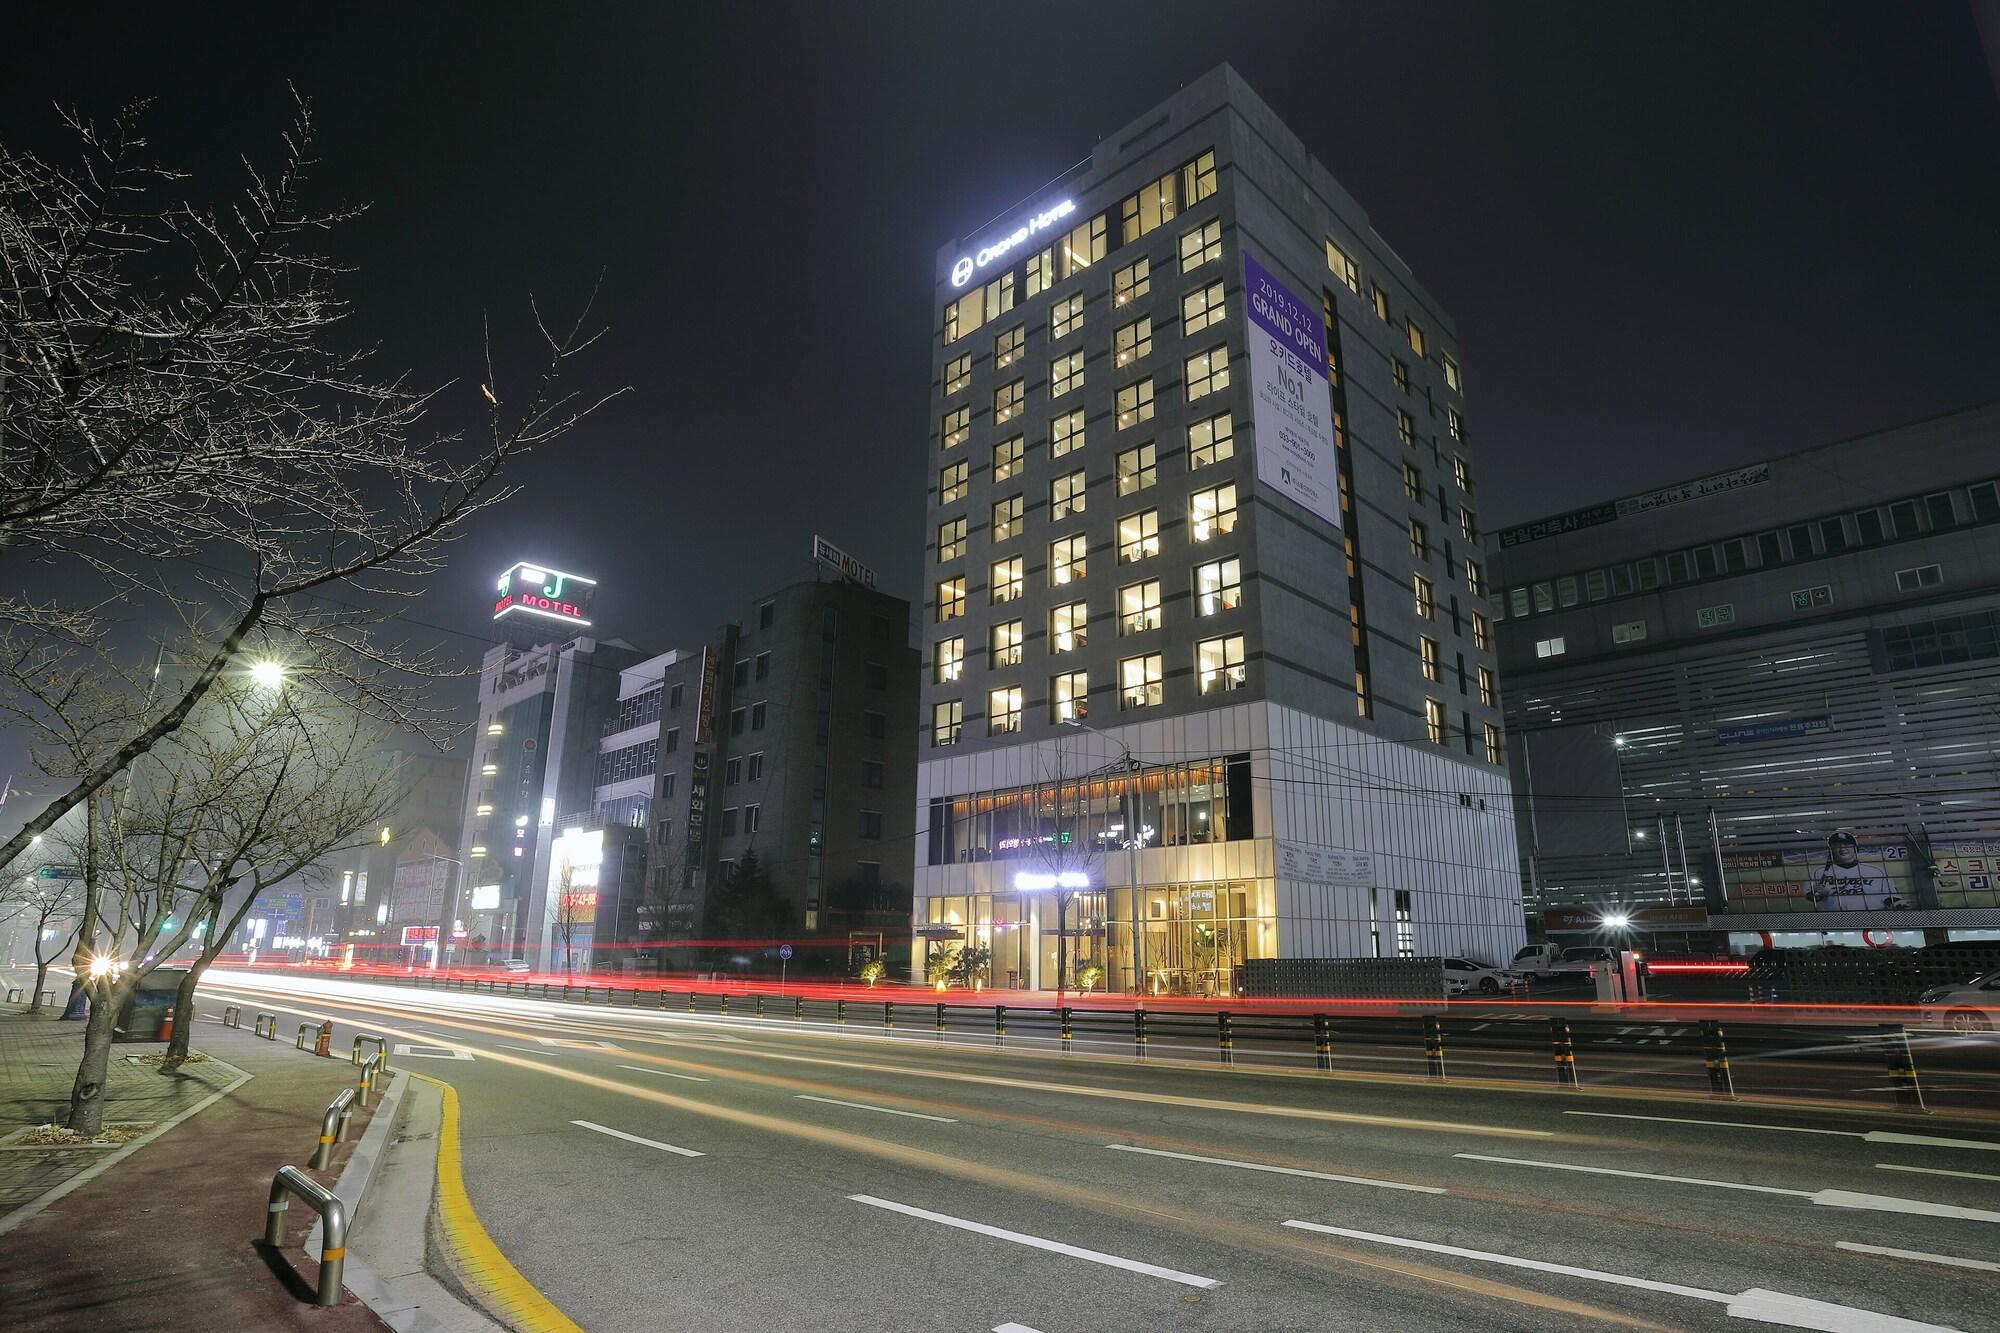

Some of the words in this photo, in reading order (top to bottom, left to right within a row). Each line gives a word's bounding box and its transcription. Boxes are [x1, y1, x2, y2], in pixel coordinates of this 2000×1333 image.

[1260, 278, 1312, 333] 2019.12.12
[1252, 293, 1292, 337] GRAND
[1295, 327, 1322, 363] OPEN
[1266, 381, 1286, 403] 라이프
[1277, 365, 1304, 402] No.1
[842, 555, 876, 588] MOTEL
[522, 594, 581, 617] MOTEL
[1887, 847, 1907, 860] 2F
[1968, 876, 2000, 889] 리
